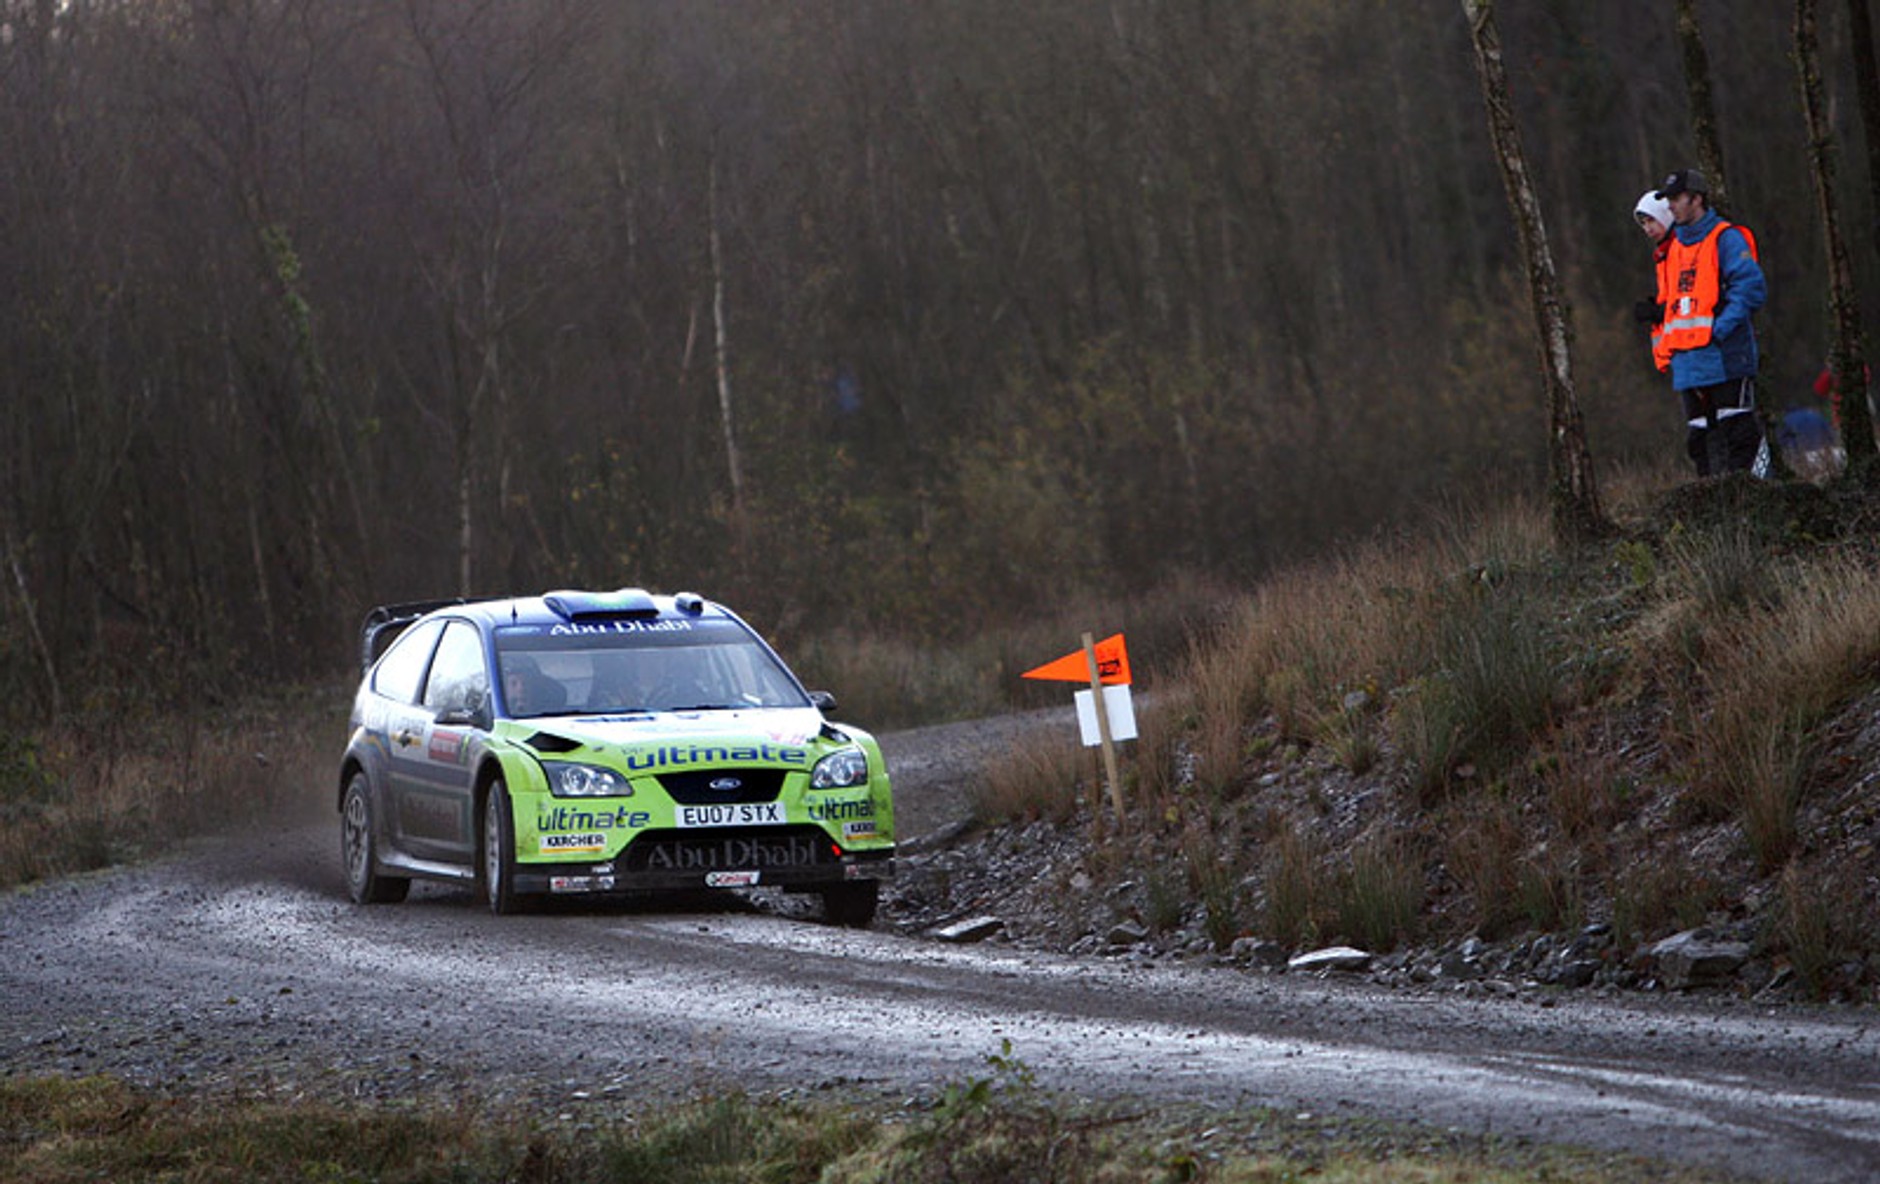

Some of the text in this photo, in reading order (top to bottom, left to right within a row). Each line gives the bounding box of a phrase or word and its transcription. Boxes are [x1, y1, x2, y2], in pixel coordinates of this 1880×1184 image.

[551, 622, 606, 636] Abu
[614, 620, 692, 633] Dhabi
[627, 744, 807, 770] ultimate
[537, 805, 651, 832] ultimate
[683, 803, 779, 826] EU07 STX
[648, 837, 817, 869] Abu Dhabi
